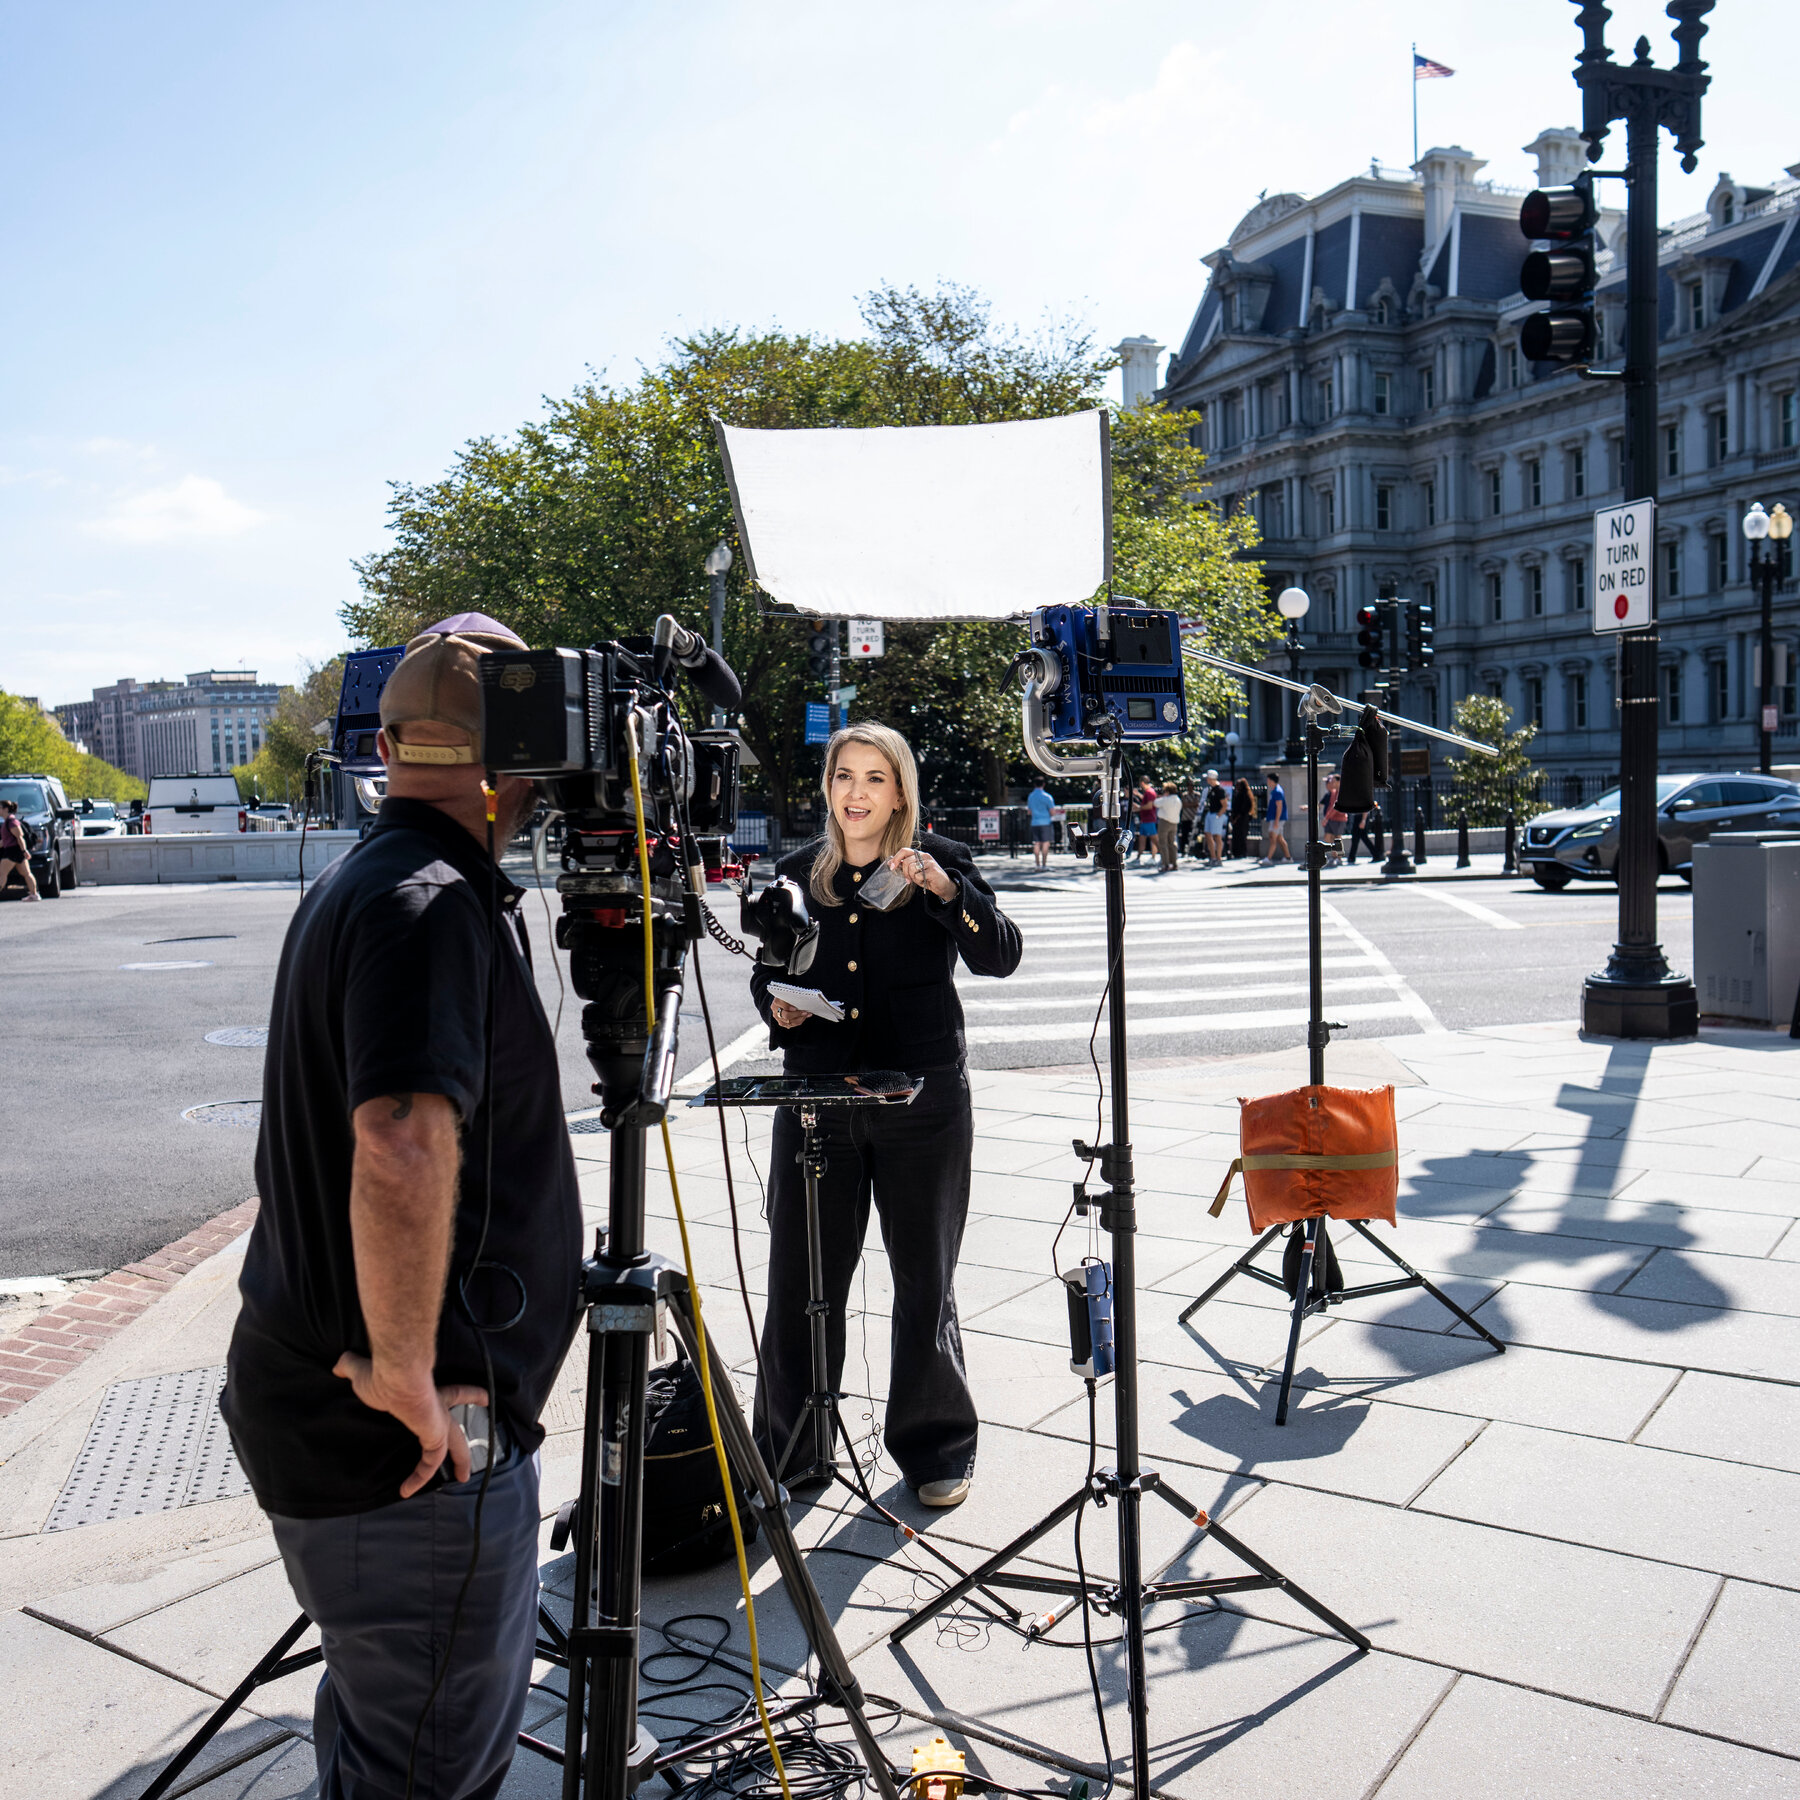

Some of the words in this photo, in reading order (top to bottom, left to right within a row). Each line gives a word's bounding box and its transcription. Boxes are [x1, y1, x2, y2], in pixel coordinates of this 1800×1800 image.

[1610, 514, 1635, 539] NO
[1607, 542, 1639, 565] TURN
[1600, 572, 1616, 592] ON
[1622, 567, 1646, 588] RED
